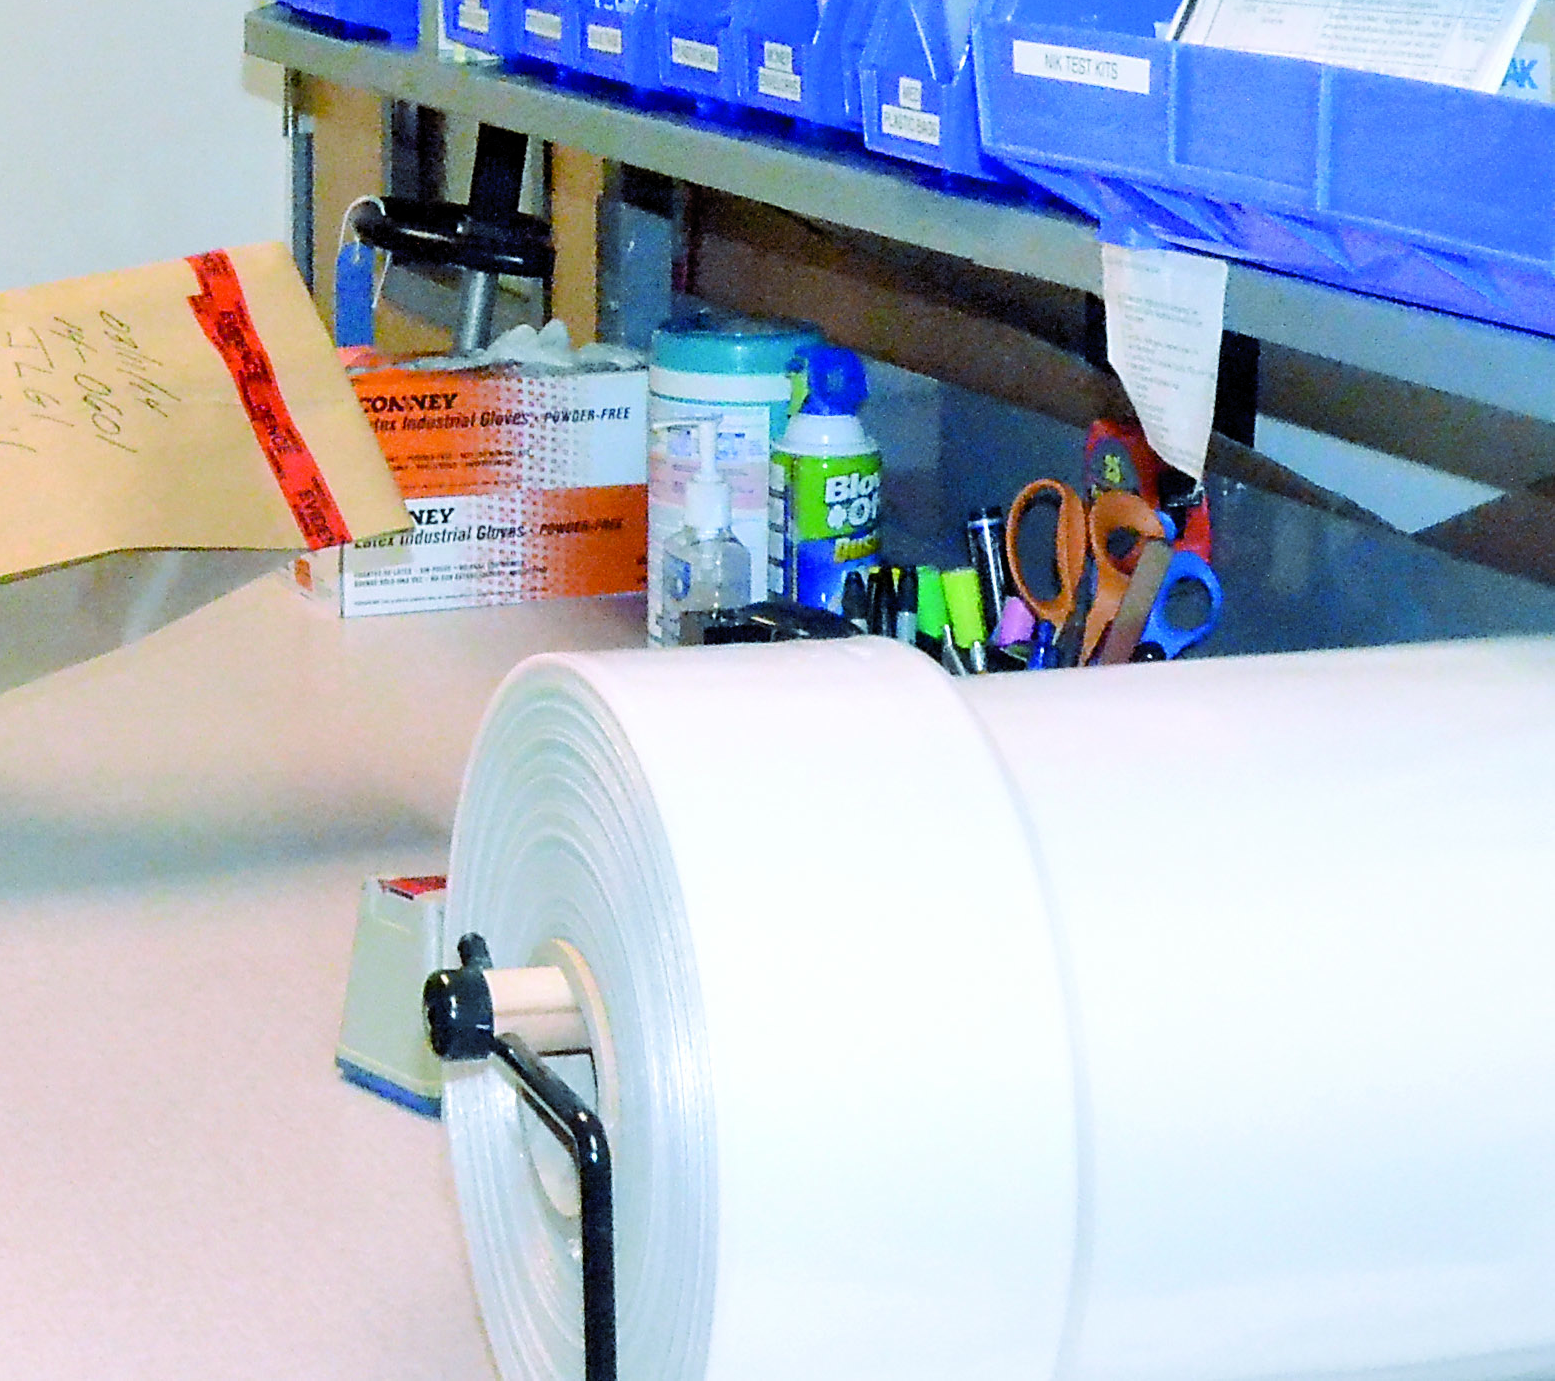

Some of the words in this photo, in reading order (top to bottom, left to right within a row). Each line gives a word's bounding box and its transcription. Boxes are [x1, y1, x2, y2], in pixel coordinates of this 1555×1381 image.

[1045, 53, 1062, 72] NIK
[1066, 54, 1092, 76] TEST
[1096, 60, 1118, 81] KITS
[402, 411, 476, 432] Industrial
[480, 408, 529, 429] Gloves
[545, 406, 632, 425] POWDER-FREE
[399, 526, 472, 547] Industrial
[476, 524, 526, 541] Gloves
